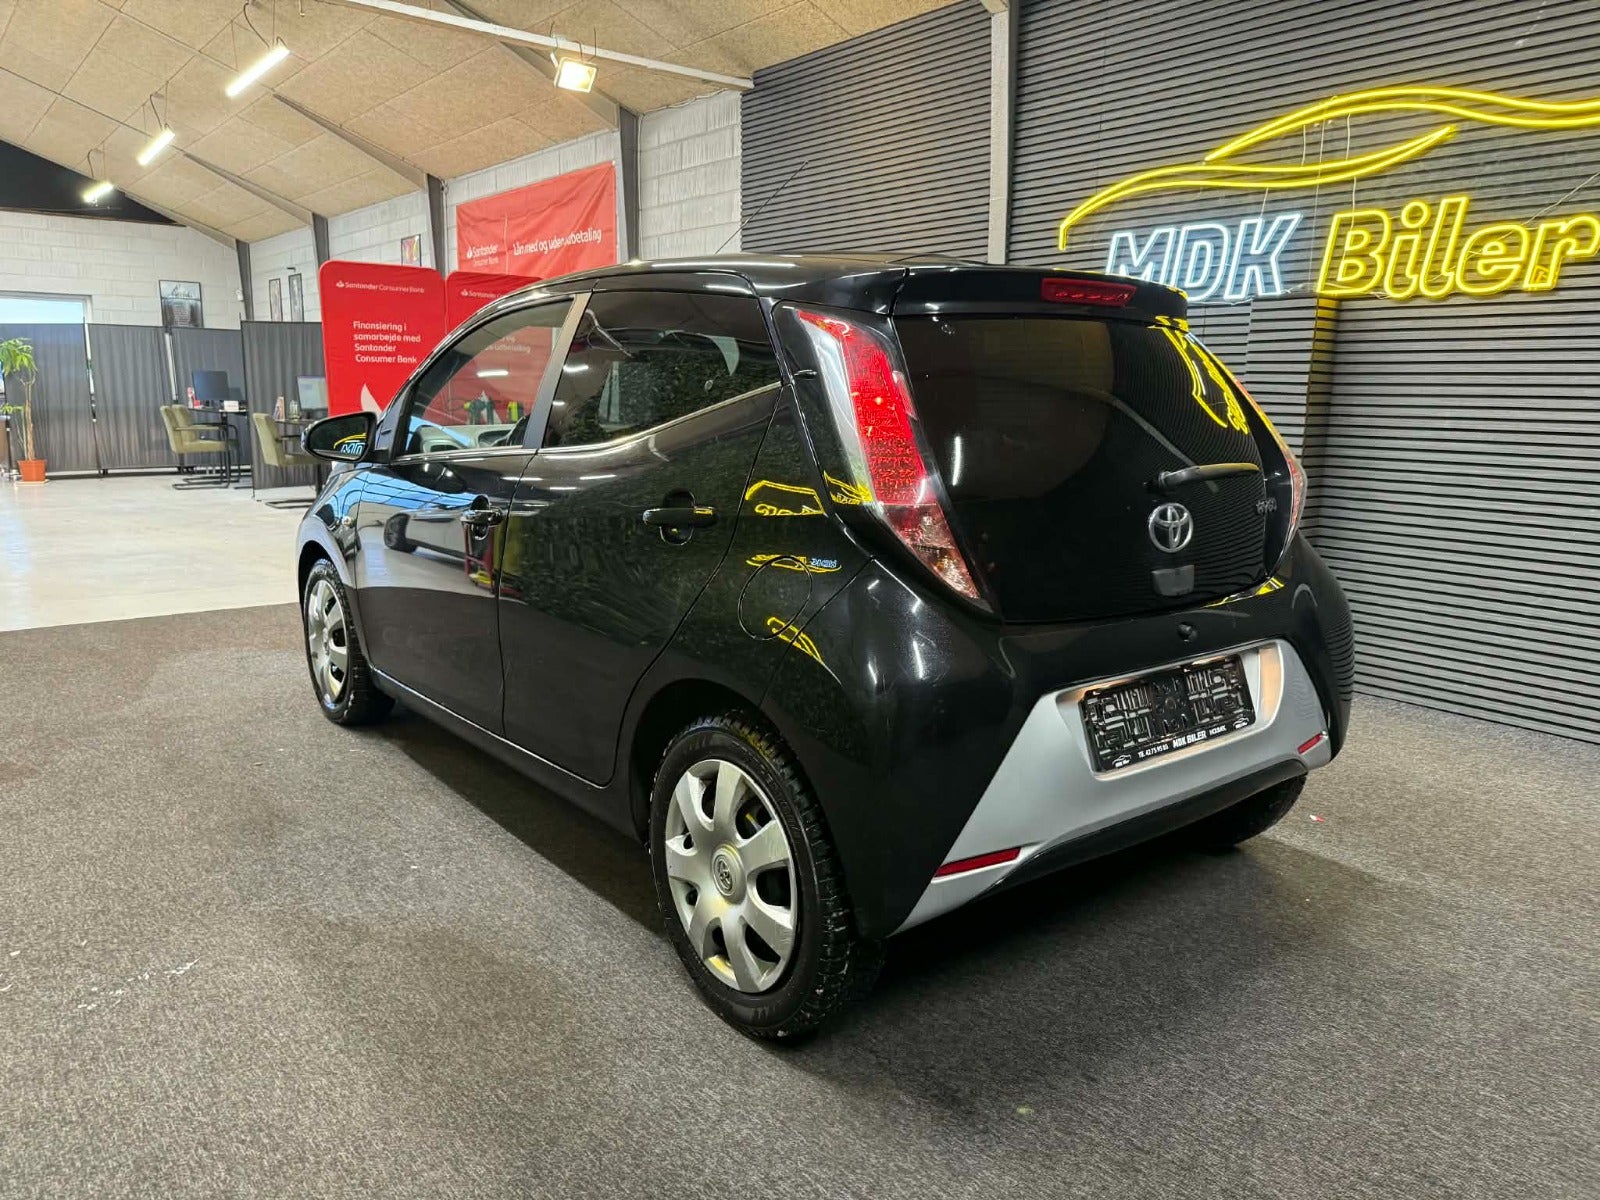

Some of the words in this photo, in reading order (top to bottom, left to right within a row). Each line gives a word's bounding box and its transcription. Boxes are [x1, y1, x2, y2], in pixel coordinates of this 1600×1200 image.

[1106, 213, 1303, 302] MDK
[1316, 195, 1600, 299] Biler
[345, 282, 378, 290] Santander
[379, 284, 408, 292] Consumer
[353, 321, 403, 333] Finansiering
[404, 323, 407, 331] i
[353, 332, 402, 343] samarbejde
[403, 335, 421, 343] med
[354, 343, 397, 352] Santander
[355, 354, 395, 363] Consumer
[397, 355, 417, 364] Bank
[1187, 730, 1207, 743] BILER
